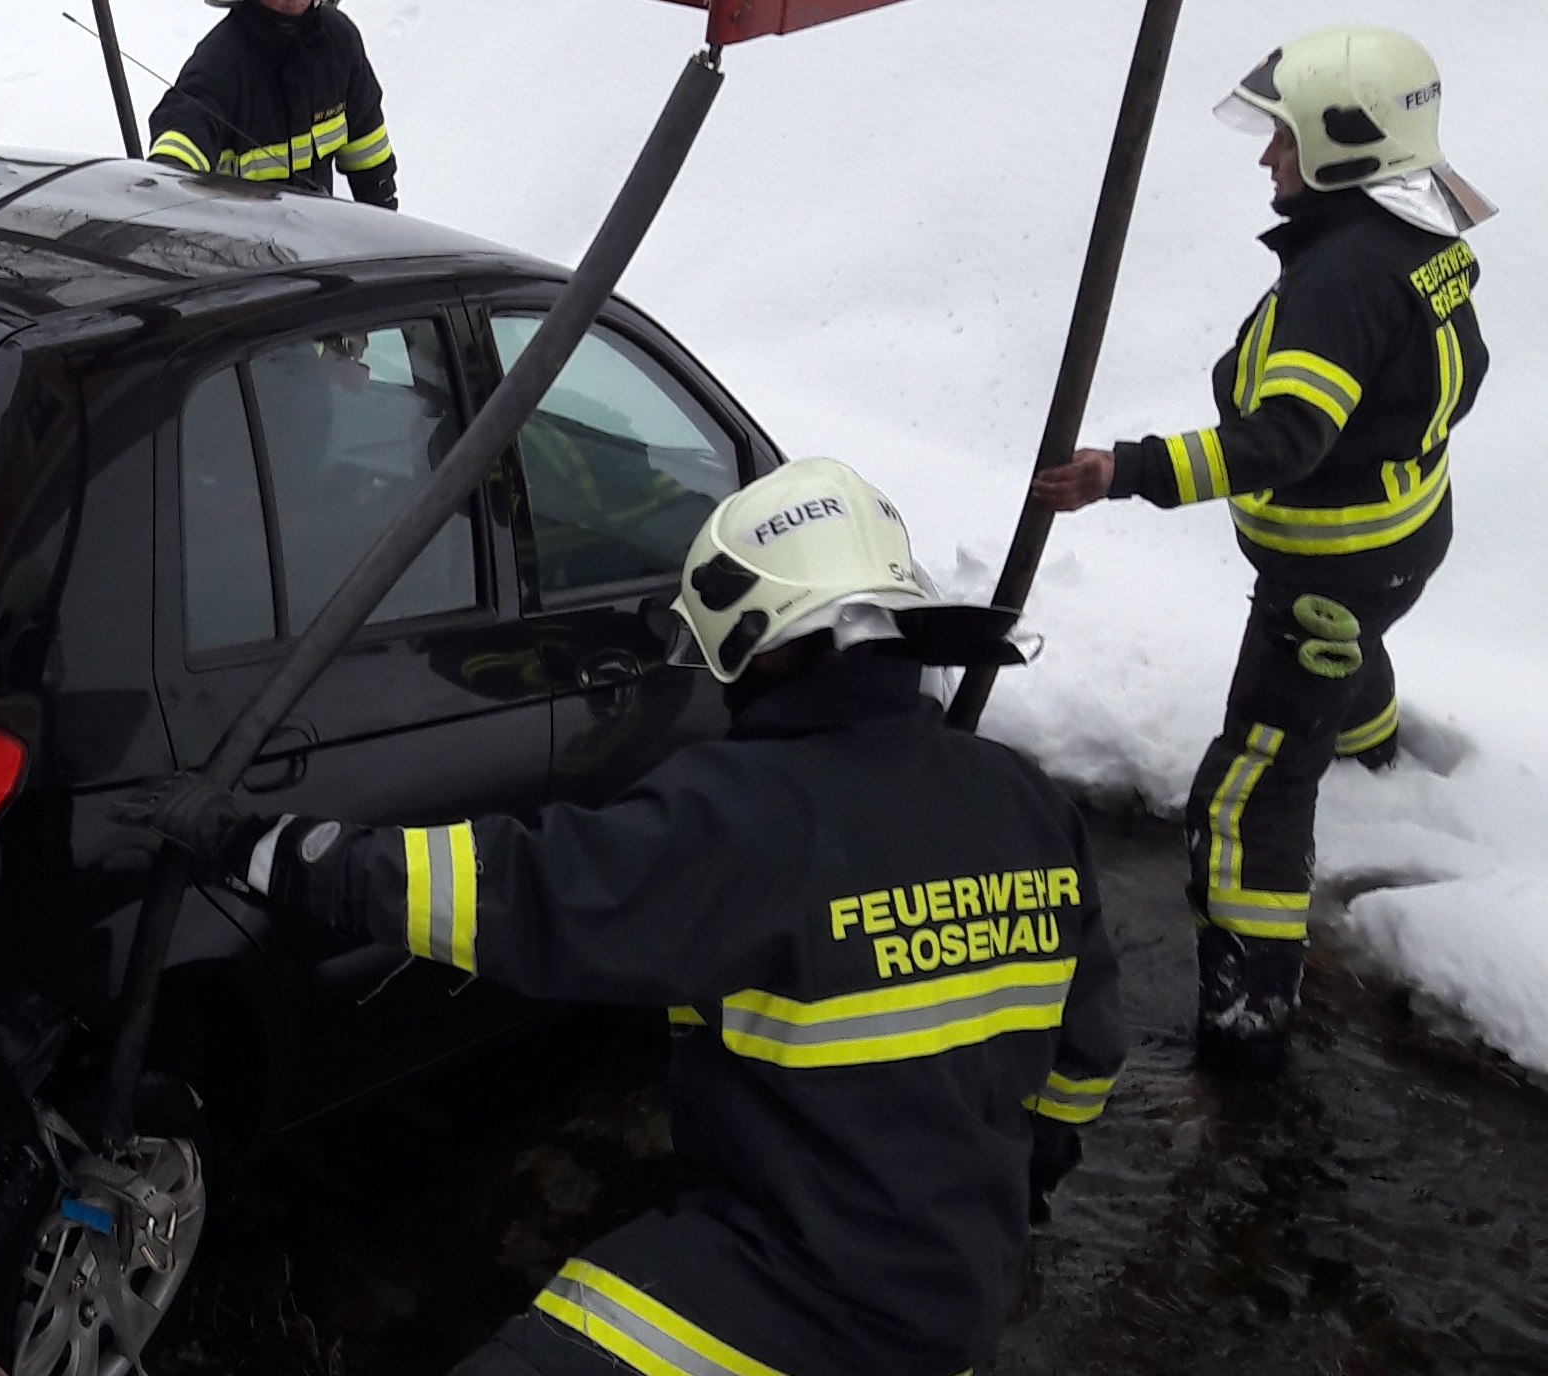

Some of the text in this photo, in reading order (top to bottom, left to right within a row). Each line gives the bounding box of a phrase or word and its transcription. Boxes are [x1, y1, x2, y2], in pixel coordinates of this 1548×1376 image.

[755, 497, 843, 545] FEUER
[829, 866, 1081, 941] FEUERWEHR
[873, 913, 1060, 979] ROSENAU
